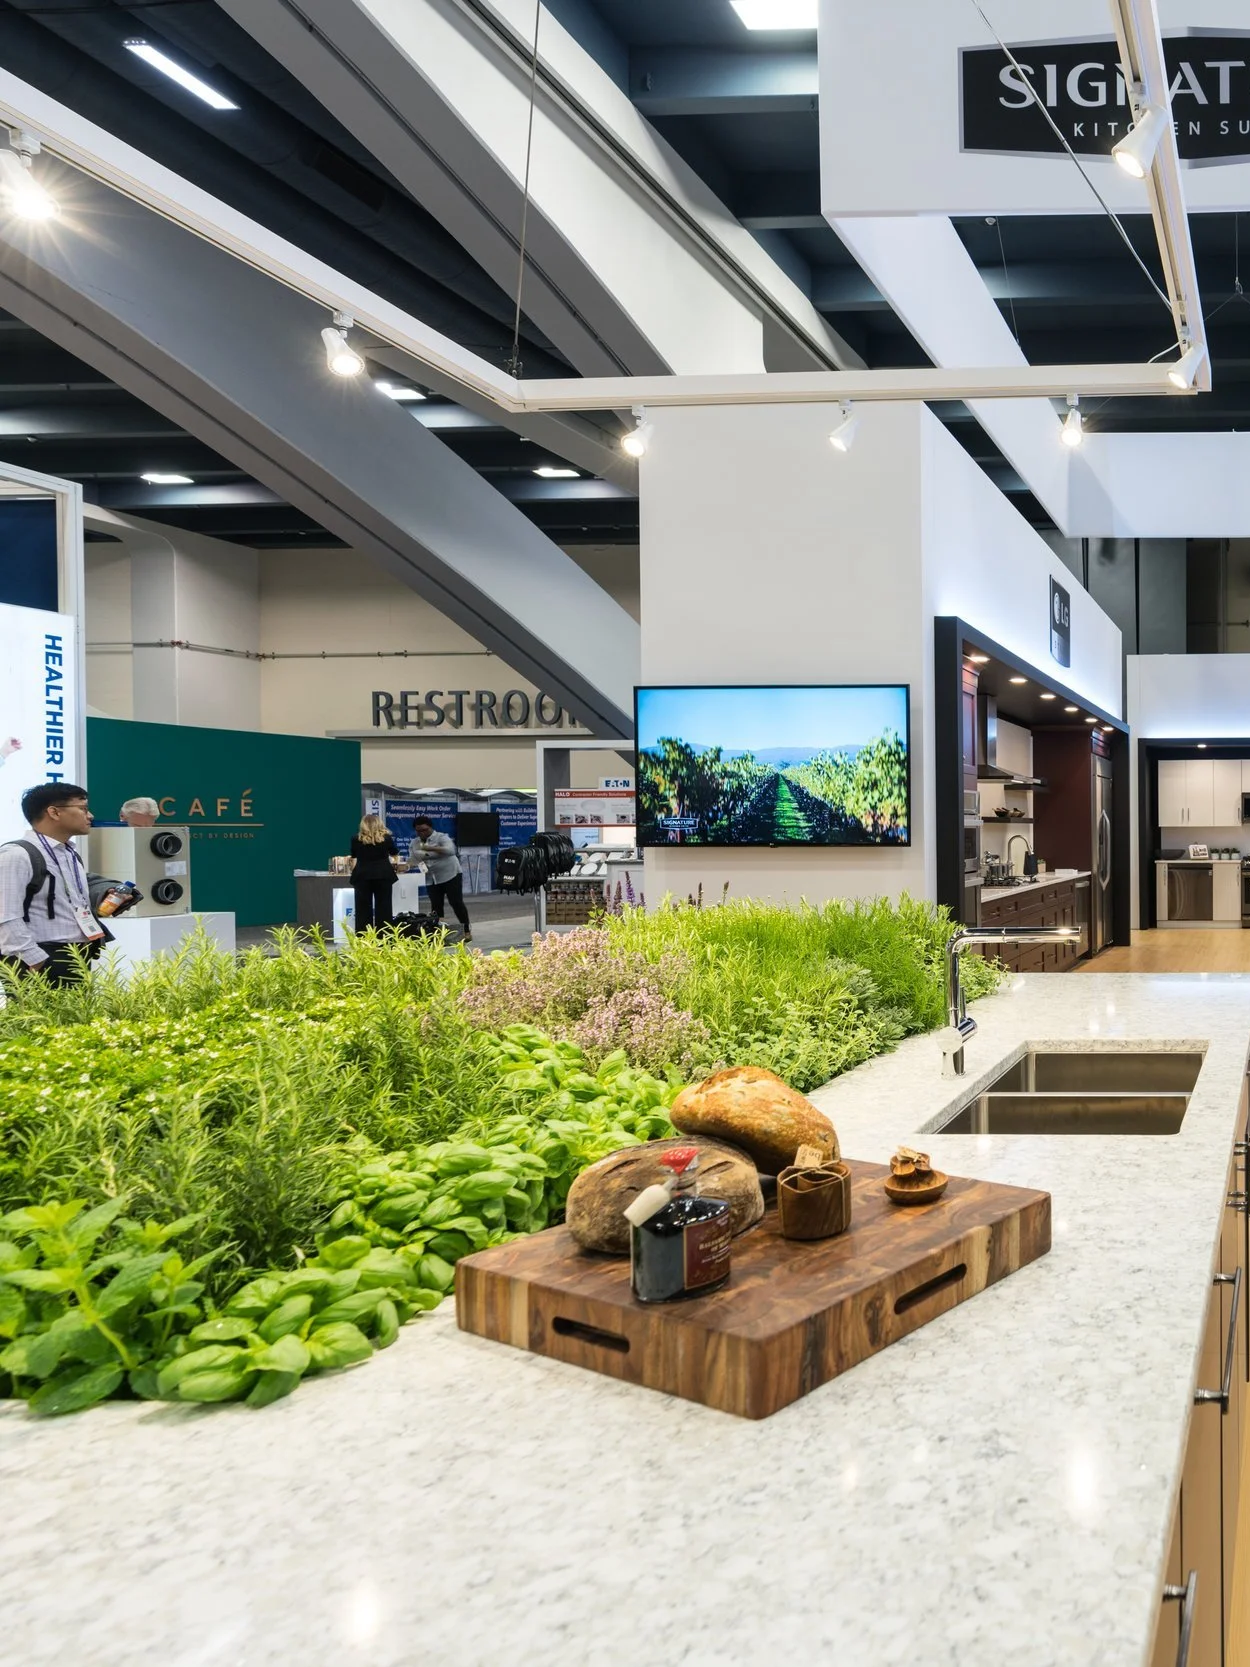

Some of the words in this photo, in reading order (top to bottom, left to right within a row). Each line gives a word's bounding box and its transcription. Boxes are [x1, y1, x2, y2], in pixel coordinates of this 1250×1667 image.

[1060, 602, 1069, 628] LG
[44, 633, 65, 766] HEALTHIER
[371, 689, 577, 727] RESTROO
[159, 788, 253, 817] CAFÉ
